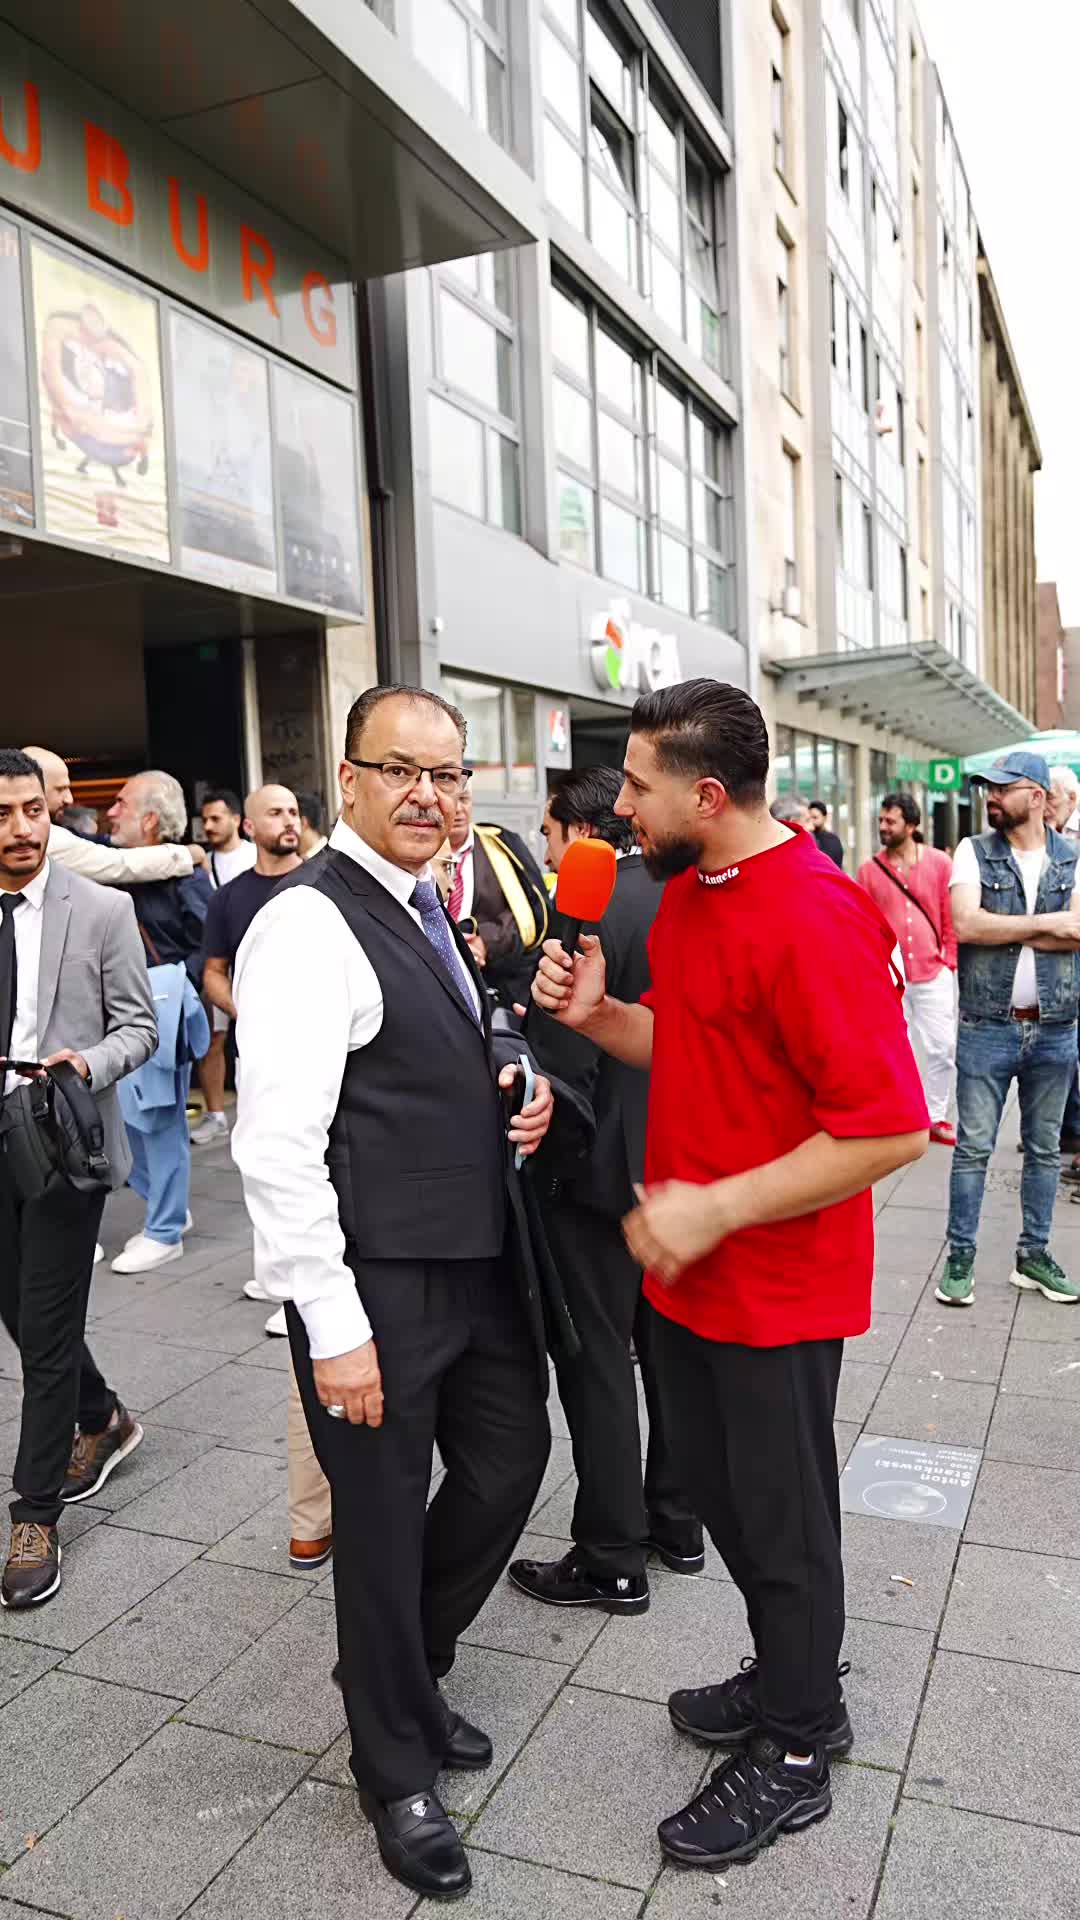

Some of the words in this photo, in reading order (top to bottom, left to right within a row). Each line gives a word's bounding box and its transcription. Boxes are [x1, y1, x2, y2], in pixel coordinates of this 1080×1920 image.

[0, 79, 338, 348] UBURG
[934, 763, 956, 785] D
[704, 865, 740, 886] Angels
[874, 1458, 973, 1480] Stankowski
[920, 1472, 971, 1488] Anton
